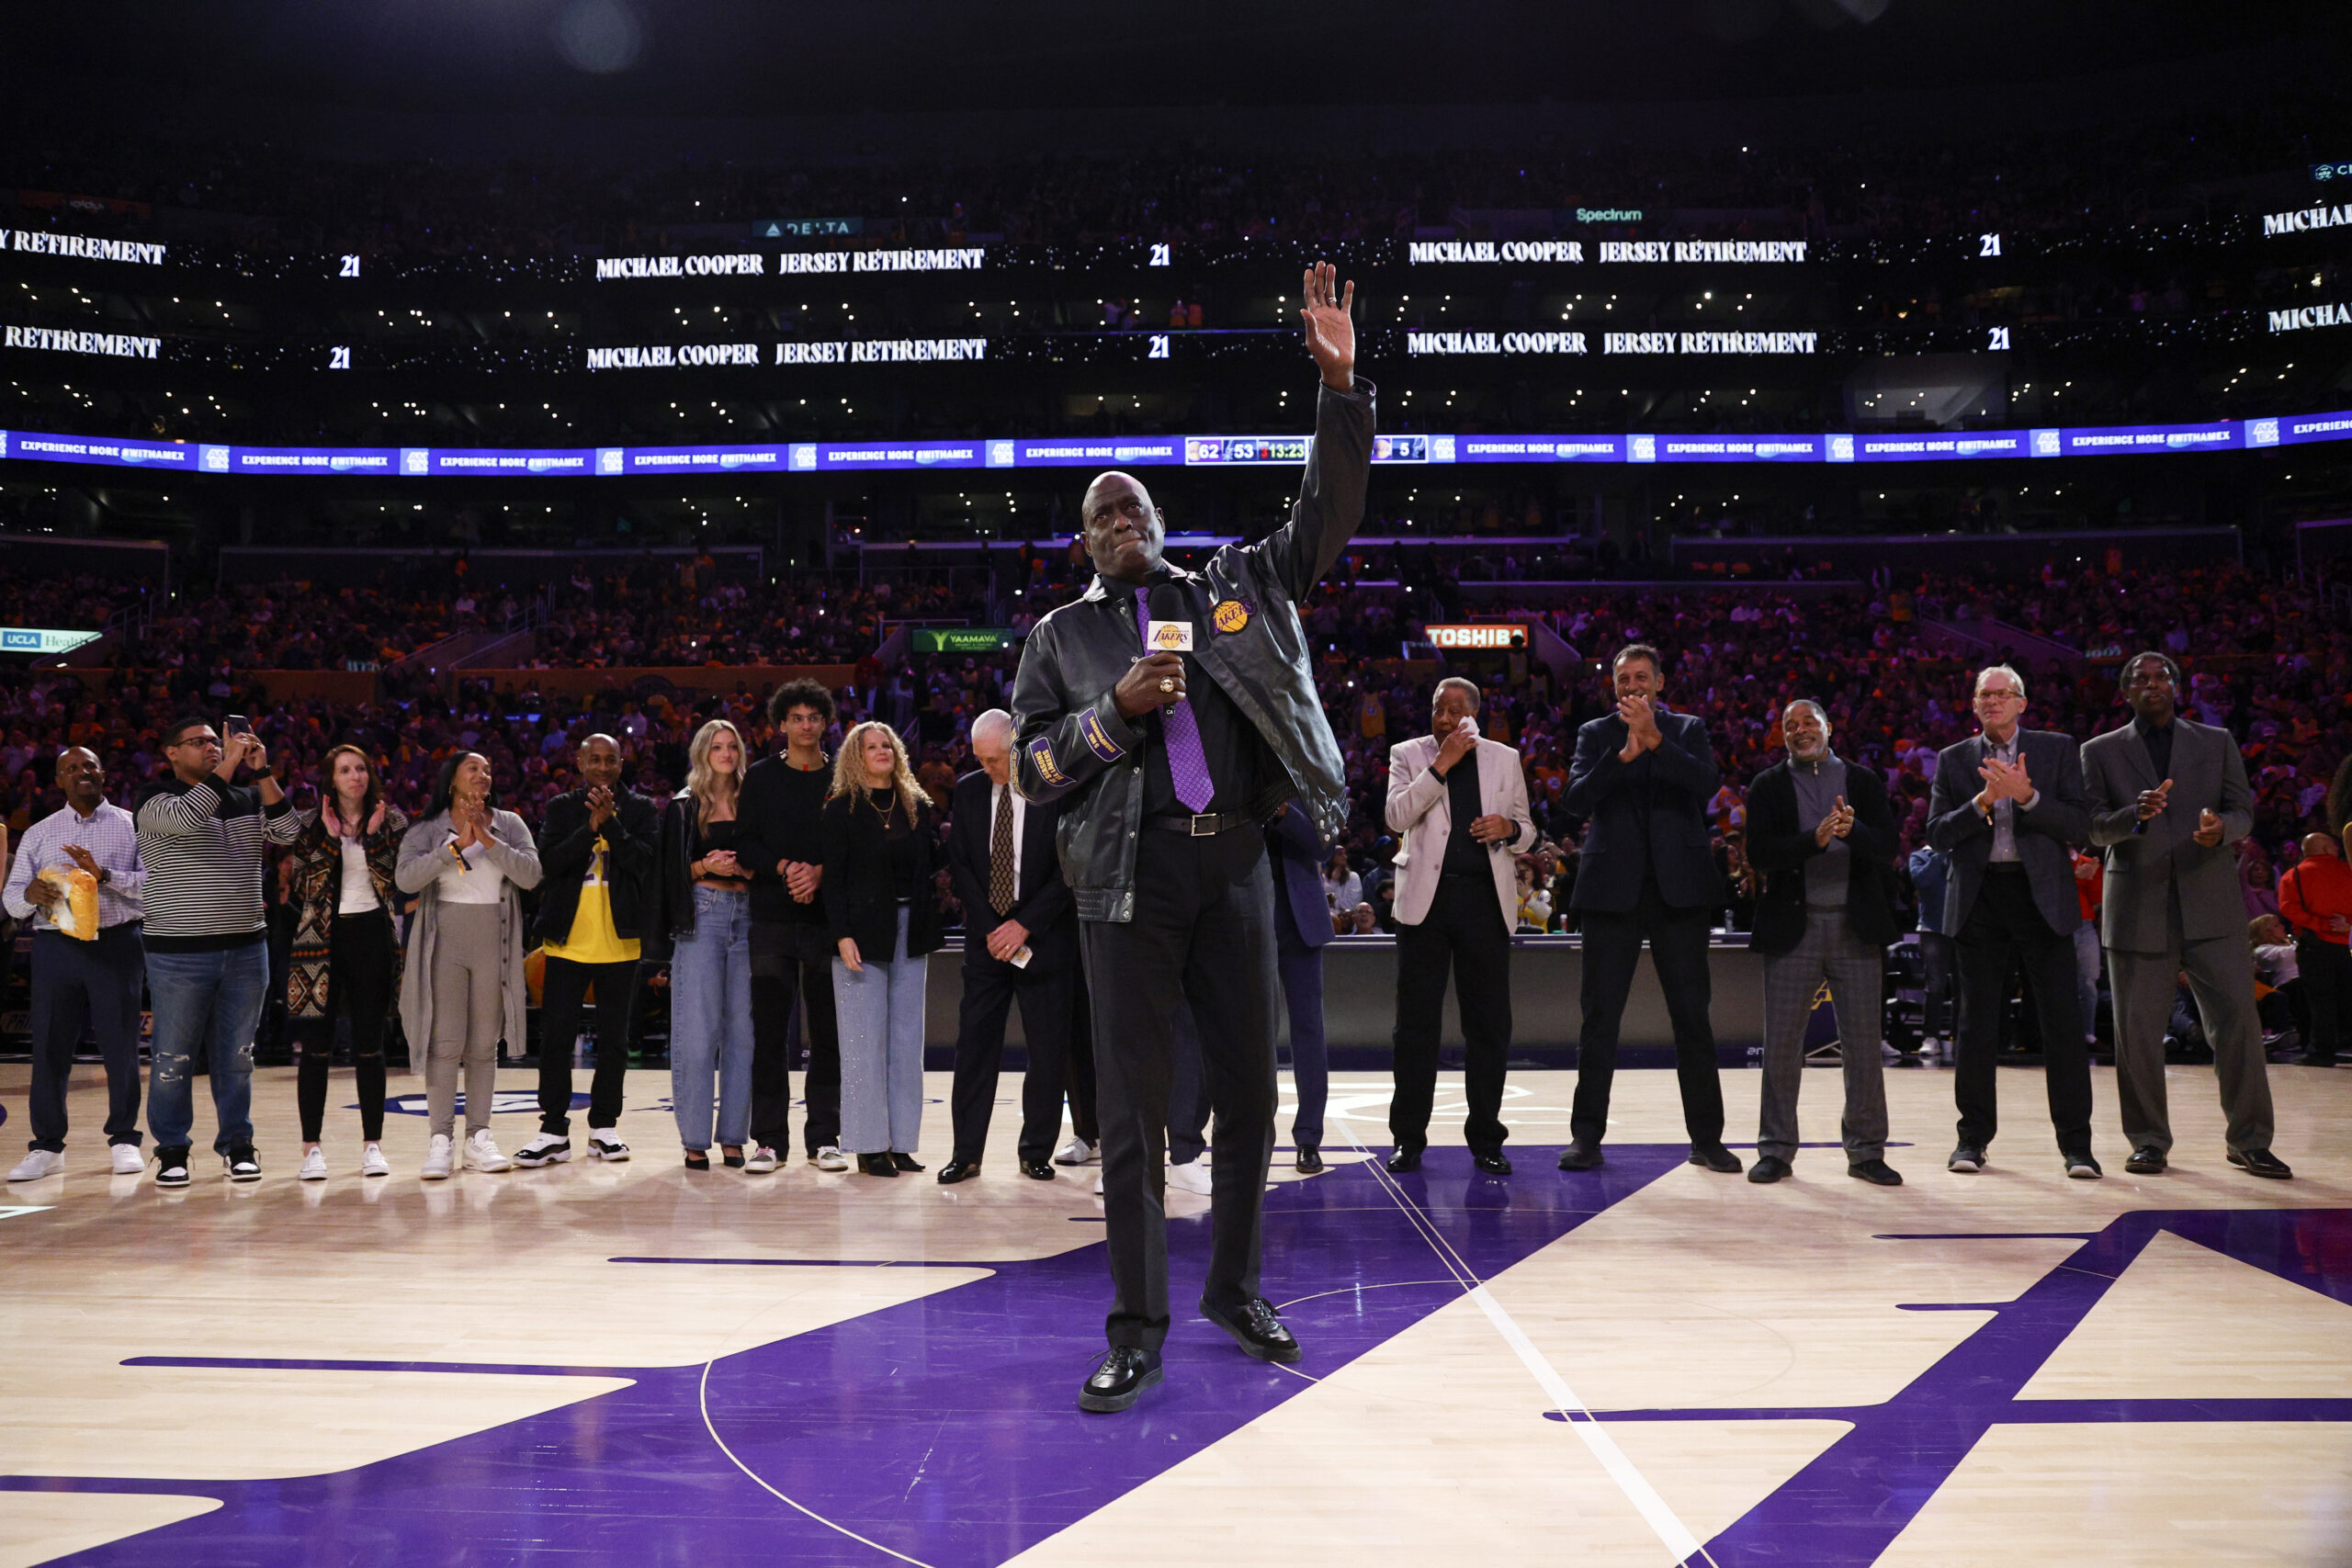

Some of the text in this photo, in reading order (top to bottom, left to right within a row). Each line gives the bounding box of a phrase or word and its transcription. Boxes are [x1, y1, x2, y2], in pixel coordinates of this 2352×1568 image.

[1576, 209, 1643, 224] Spectrum
[14, 230, 166, 265] RETIREMENT
[1979, 232, 2001, 256] 21
[1149, 243, 1170, 265] 21
[1408, 241, 1807, 263] MICHAEL COOPER JERSEY RETIREMENT
[339, 254, 360, 277] 21
[596, 248, 985, 279] MICHAEL COOPER JERSEY RETIREMENT
[2267, 303, 2352, 333] MICHA
[5, 325, 162, 358] RETIREMENT
[1148, 334, 1170, 357] 21
[1407, 332, 1817, 355] MICHAEL COOPER JERSEY RETIREMENT
[1987, 326, 2009, 350] 21
[329, 345, 350, 368] 21
[586, 338, 988, 369] MICHAEL COOPER JERSEY RETIREMENT
[1864, 442, 1924, 453] EXPERIENCE
[1926, 441, 1954, 452] MORE
[2072, 435, 2133, 446] EXPERIENCE
[2136, 434, 2165, 444] MORE
[20, 441, 86, 455] EXPERIENCE
[89, 446, 119, 456] MORE
[829, 451, 885, 461] EXPERIENCE
[887, 450, 913, 460] MORE
[1026, 447, 1083, 458] EXPERIENCE
[1085, 447, 1112, 457] MORE
[1199, 444, 1219, 458] 62
[1234, 444, 1253, 458] 53
[1269, 444, 1304, 457] 13:23
[1399, 442, 1409, 457] 5
[1467, 444, 1524, 454] EXPERIENCE
[1526, 444, 1554, 453] MORE
[1667, 444, 1724, 453] EXPERIENCE
[1726, 444, 1753, 453] MORE
[242, 456, 300, 466] EXPERIENCE
[301, 457, 328, 466] MORE
[440, 457, 497, 467] EXPERIENCE
[499, 457, 526, 468] MORE
[634, 455, 690, 466] EXPERIENCE
[692, 454, 719, 464] MORE
[1213, 597, 1257, 634] LAKERS
[7, 635, 38, 645] UCLA
[1154, 628, 1191, 643] LAKERS
[1035, 750, 1052, 781] SEASONS
